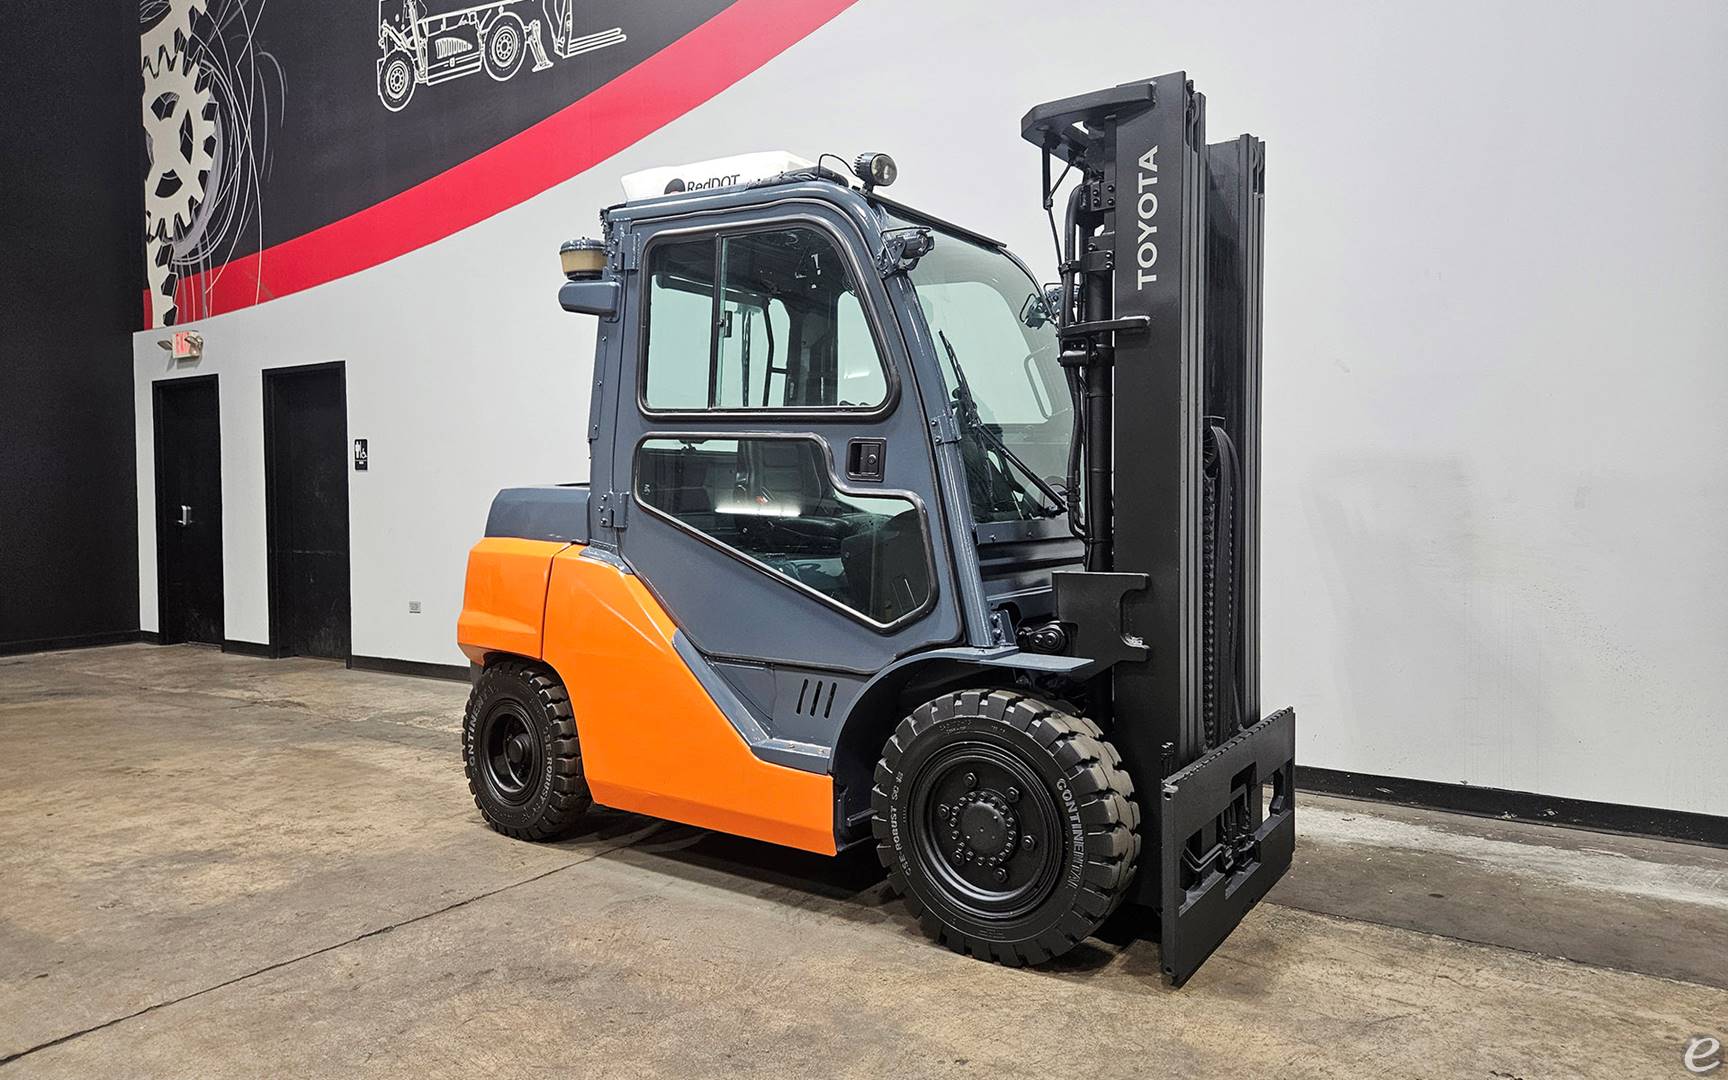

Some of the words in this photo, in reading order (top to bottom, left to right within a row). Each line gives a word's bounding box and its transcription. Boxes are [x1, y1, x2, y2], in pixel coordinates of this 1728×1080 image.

[687, 174, 740, 192] RedDOT
[1137, 145, 1158, 290] TOYOTA
[1056, 778, 1085, 889] CONTINENTAL
